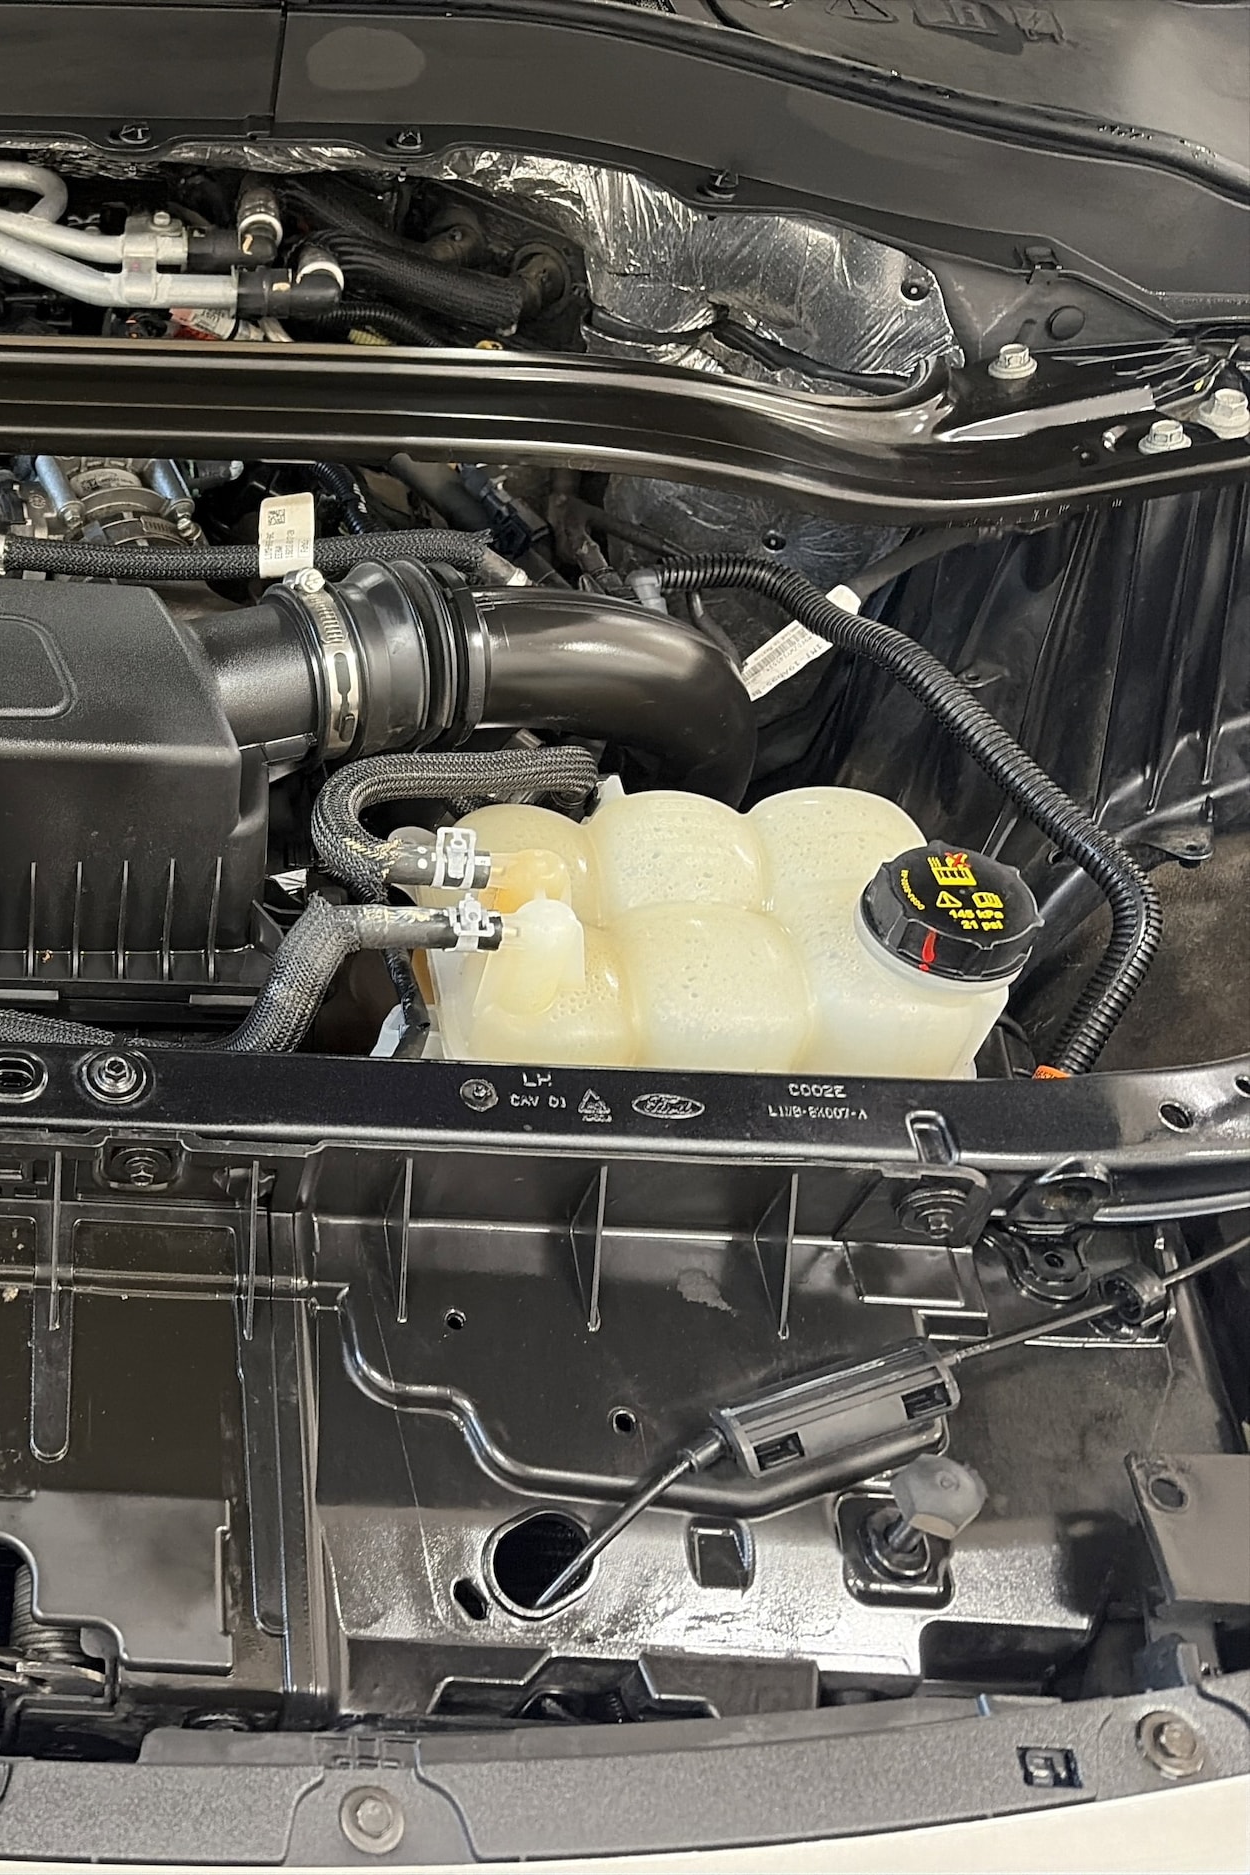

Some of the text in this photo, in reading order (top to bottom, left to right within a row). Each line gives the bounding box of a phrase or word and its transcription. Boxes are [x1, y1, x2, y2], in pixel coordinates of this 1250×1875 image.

[949, 909, 1004, 920] 145 kPa
[961, 920, 1003, 932] 21 psi
[510, 1093, 540, 1108] CAV
